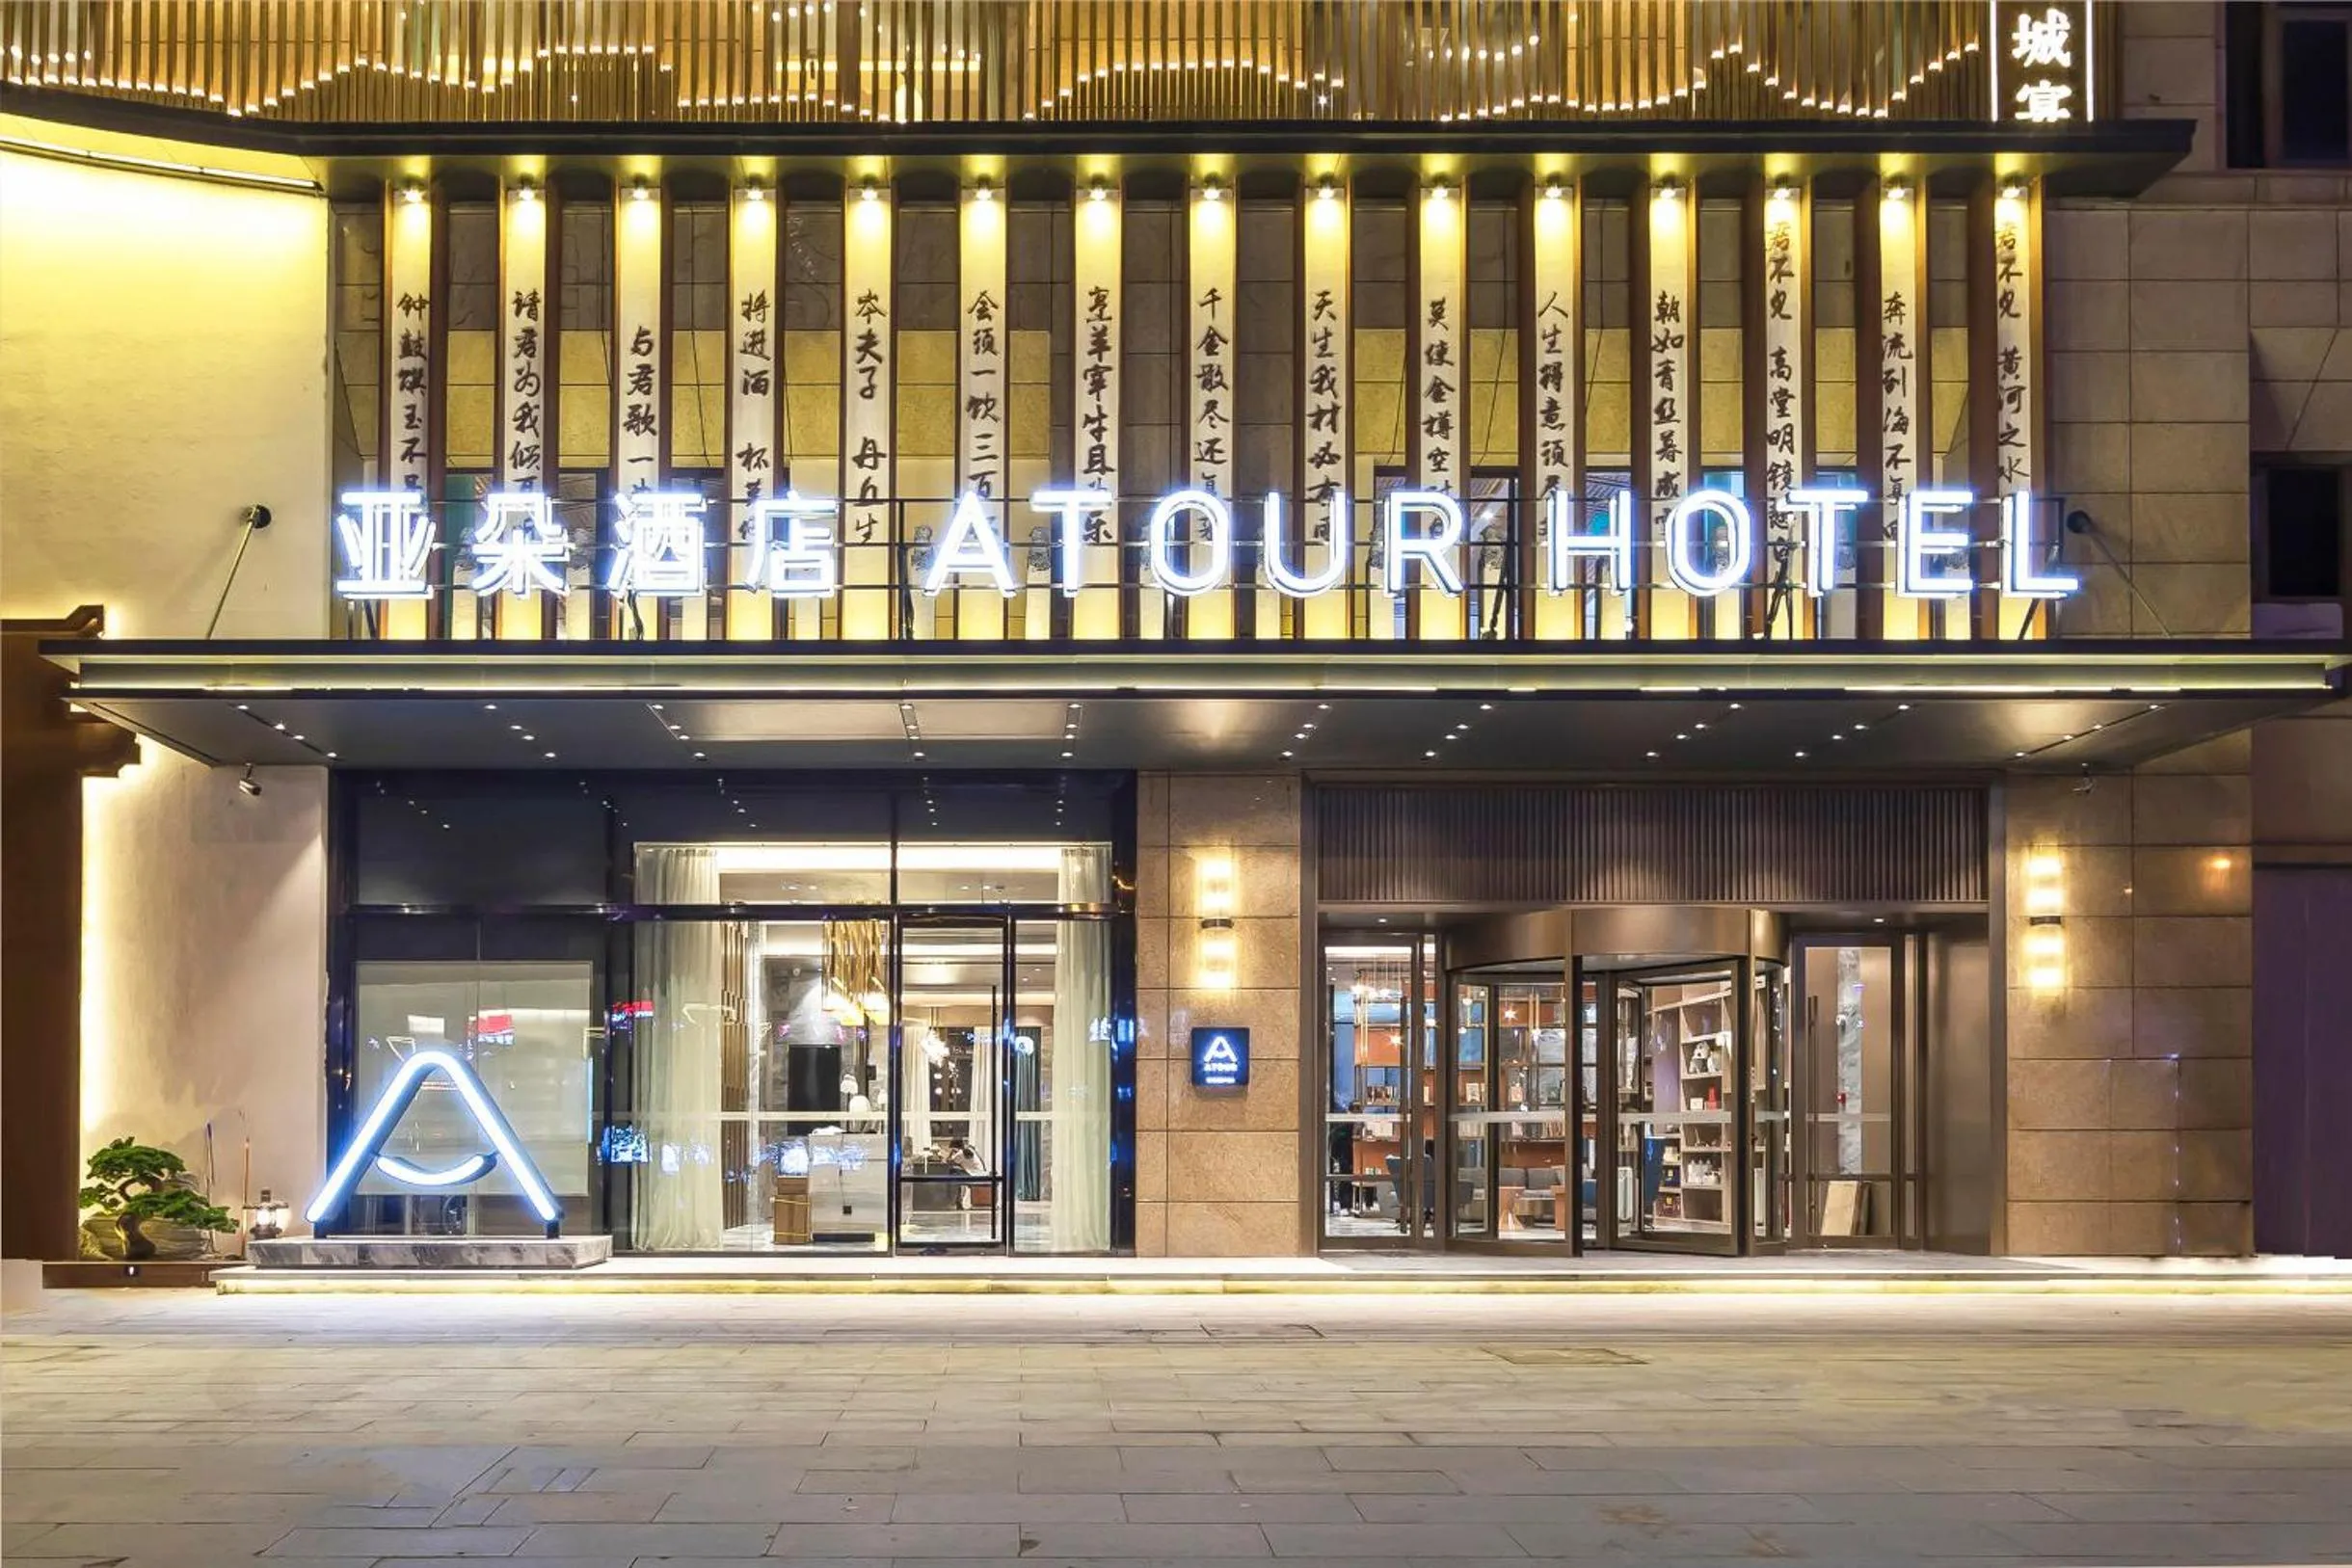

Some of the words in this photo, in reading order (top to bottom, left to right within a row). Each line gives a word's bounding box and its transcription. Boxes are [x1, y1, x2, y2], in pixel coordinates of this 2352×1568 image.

[336, 489, 838, 599] 亚朵酒店
[922, 489, 1465, 598] ATOUR
[1547, 489, 2079, 599] HOTEL
